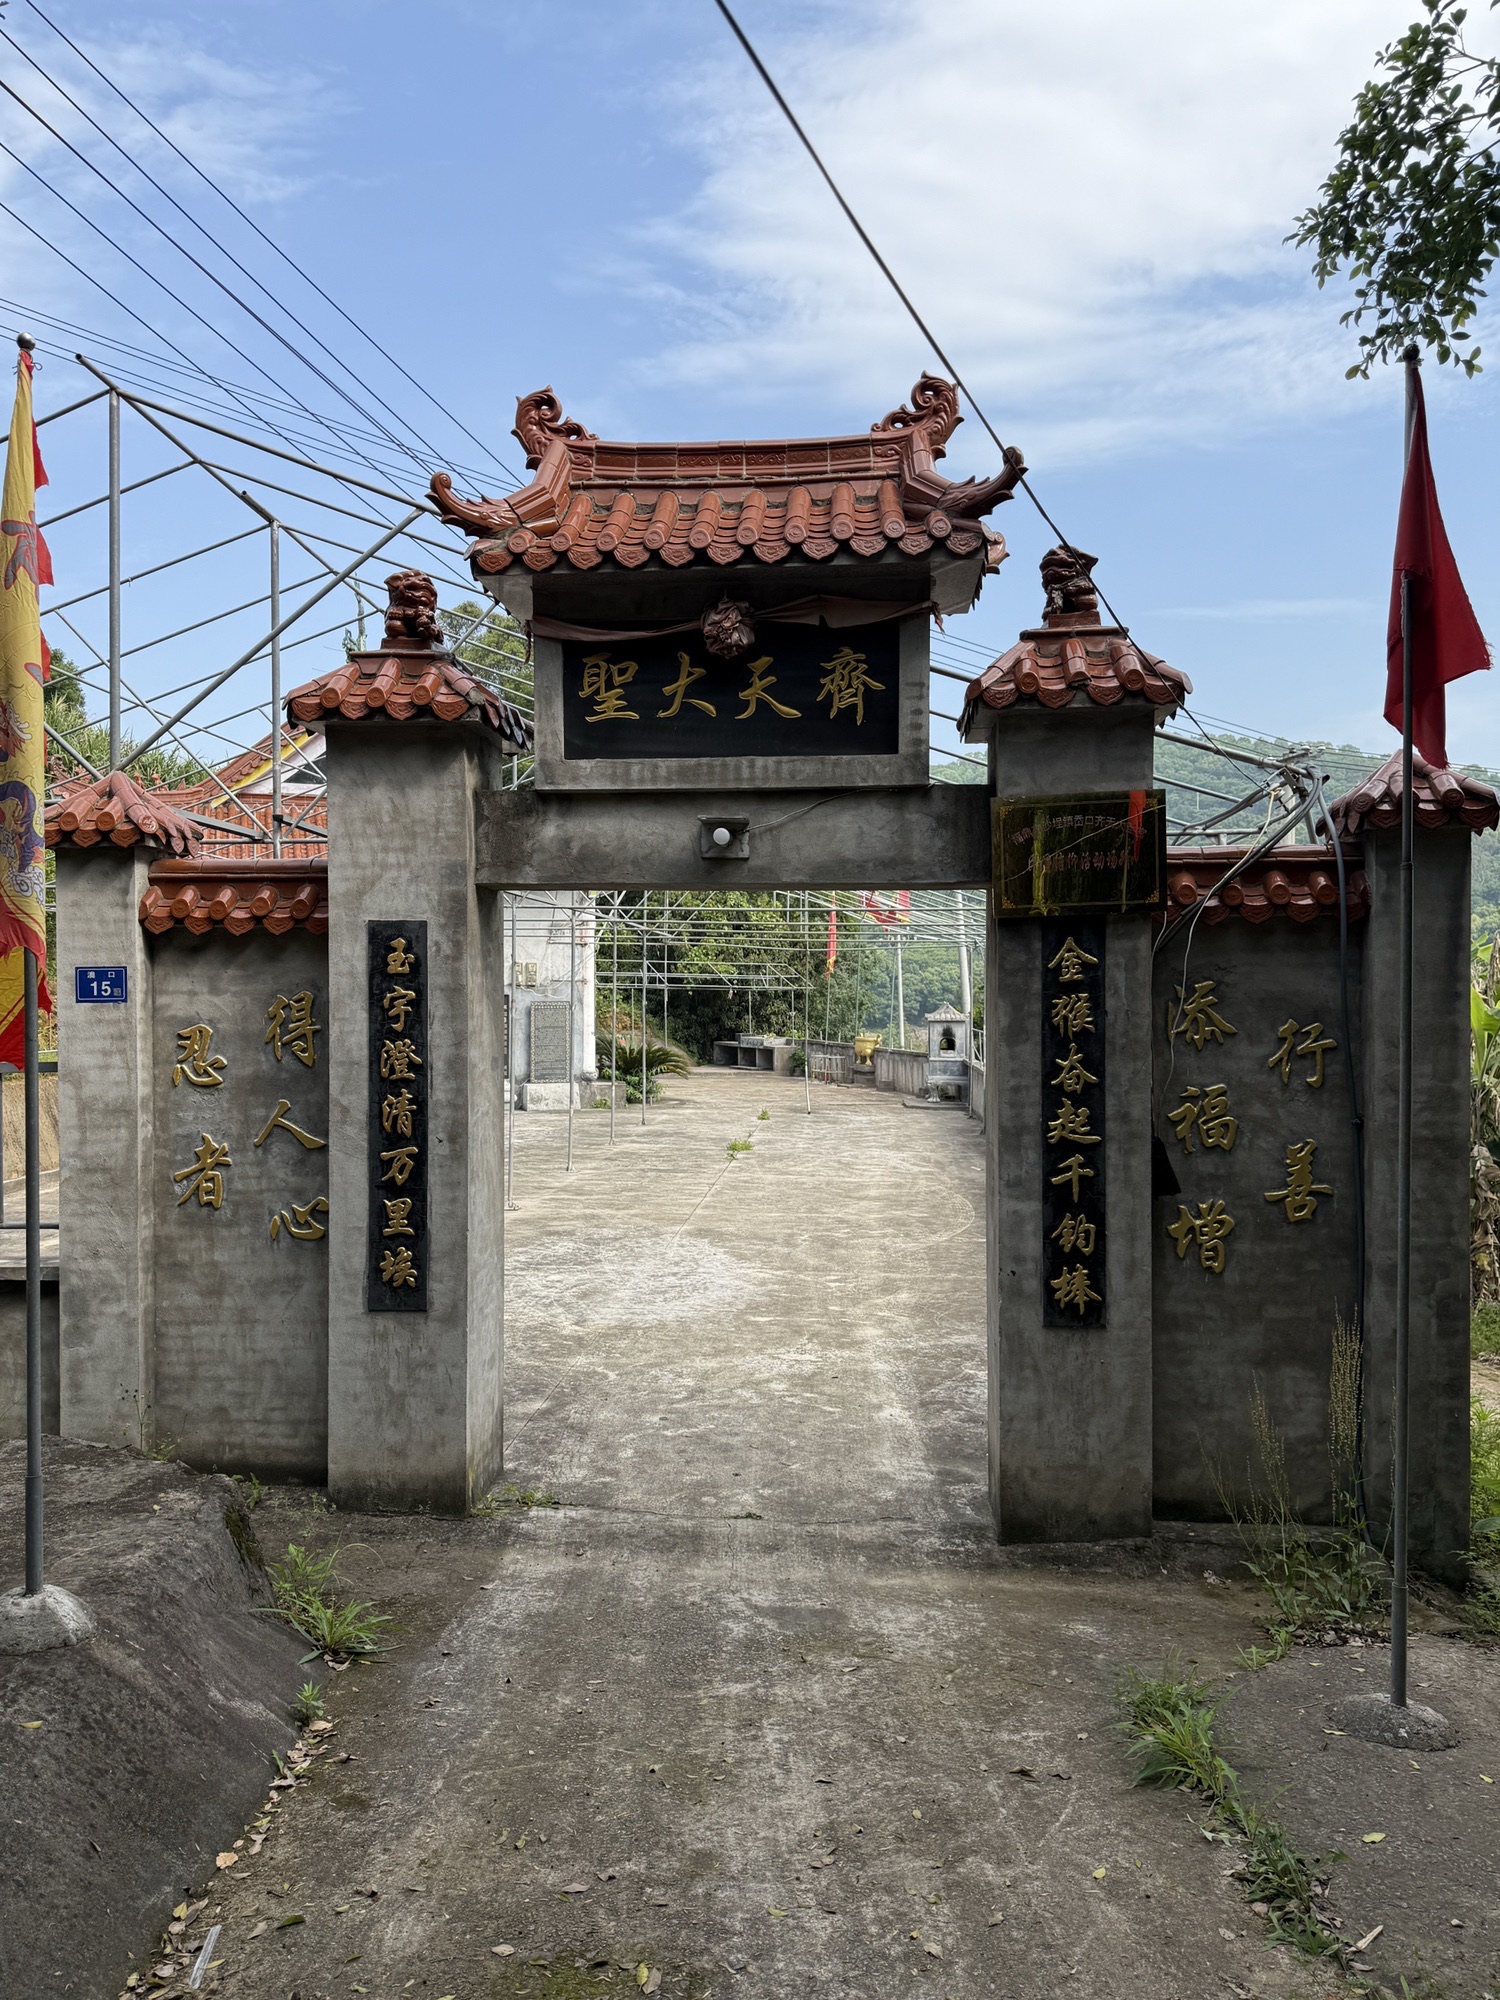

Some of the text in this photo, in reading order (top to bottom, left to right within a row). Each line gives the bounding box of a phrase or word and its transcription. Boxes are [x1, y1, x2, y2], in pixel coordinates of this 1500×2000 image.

[90, 981, 111, 996] 15
[171, 1023, 232, 1209] 忍者
[254, 990, 329, 1241] 得人心
[379, 937, 423, 1288] 玉宇澄清万里埃
[1167, 980, 1238, 1274] 添福增
[1264, 1018, 1337, 1223] 行善
